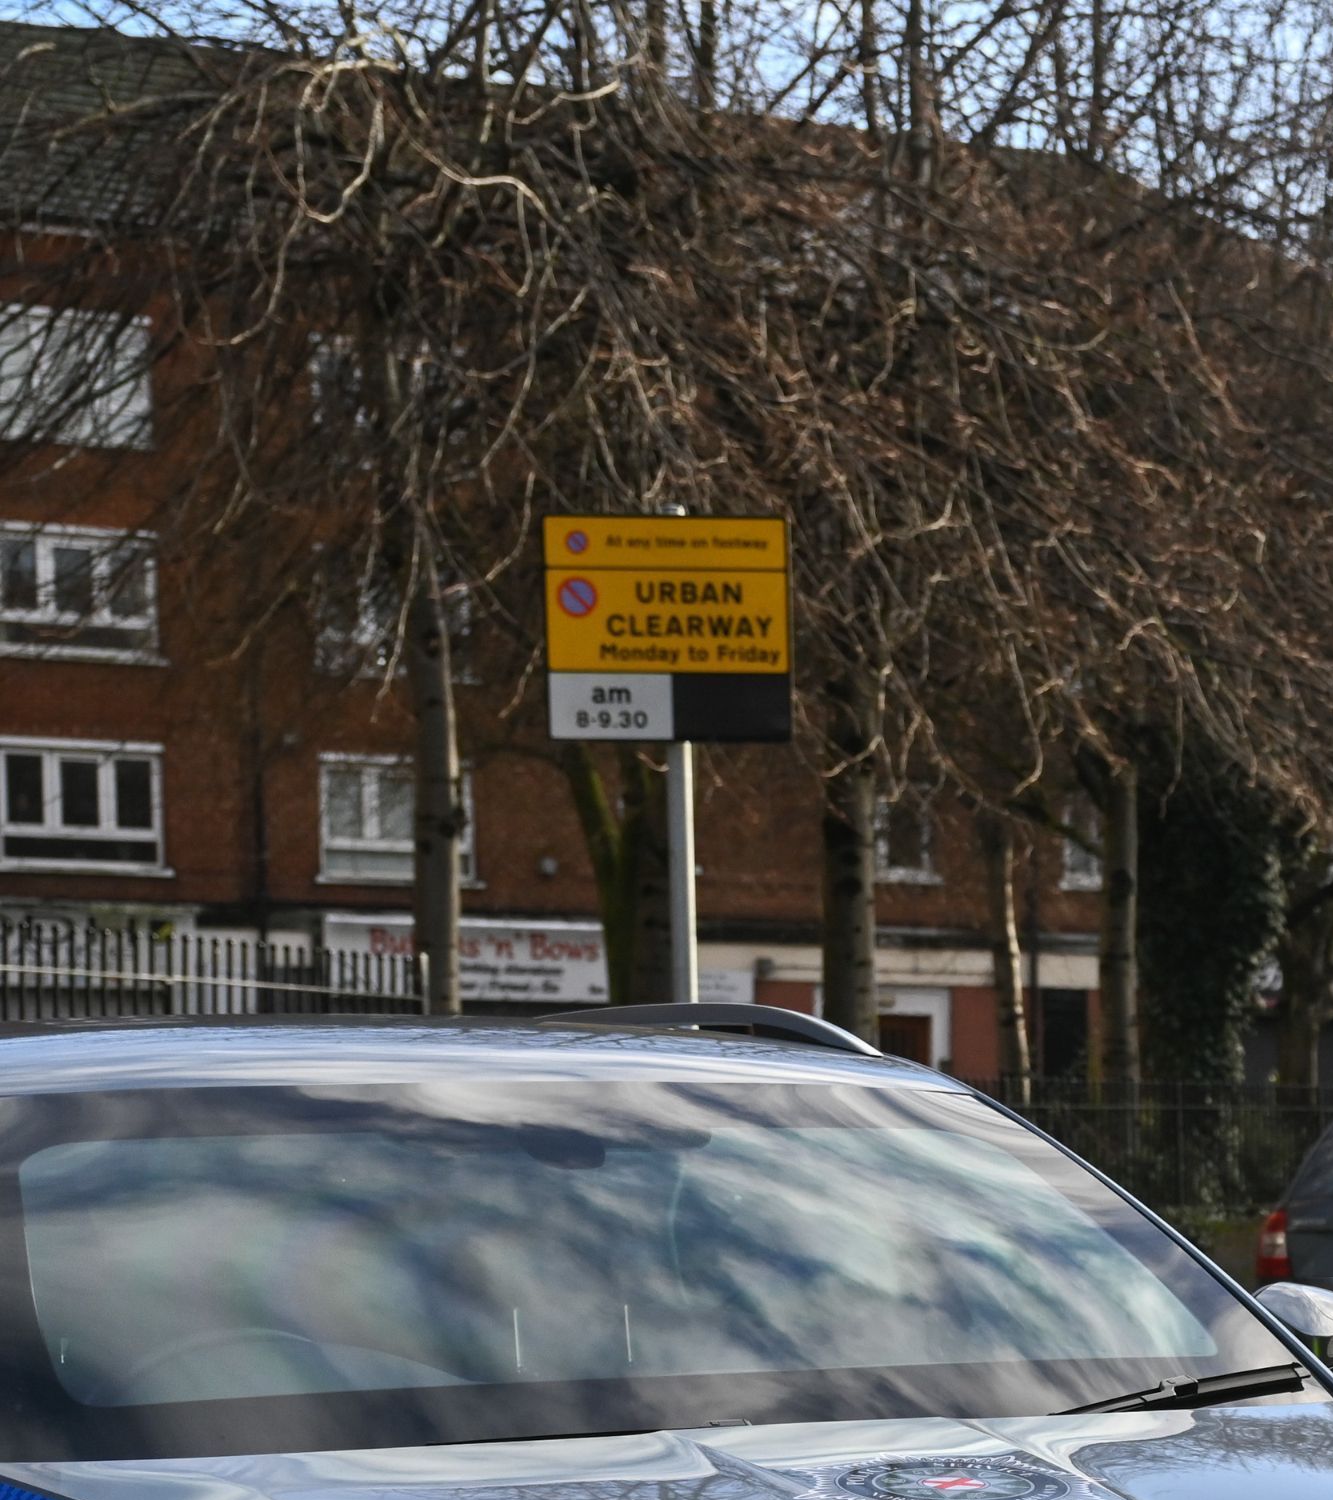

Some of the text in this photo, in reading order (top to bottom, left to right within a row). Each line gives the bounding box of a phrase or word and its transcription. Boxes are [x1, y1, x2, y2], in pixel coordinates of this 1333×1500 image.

[655, 536, 686, 548] time
[691, 538, 708, 549] on
[712, 536, 768, 551] footway
[635, 581, 743, 605] URBAN
[606, 613, 772, 638] CLEARWAY
[600, 643, 781, 667] Monday to Friday
[591, 687, 632, 704] am
[575, 710, 649, 730] 8-9.30
[529, 931, 600, 961] Bows
